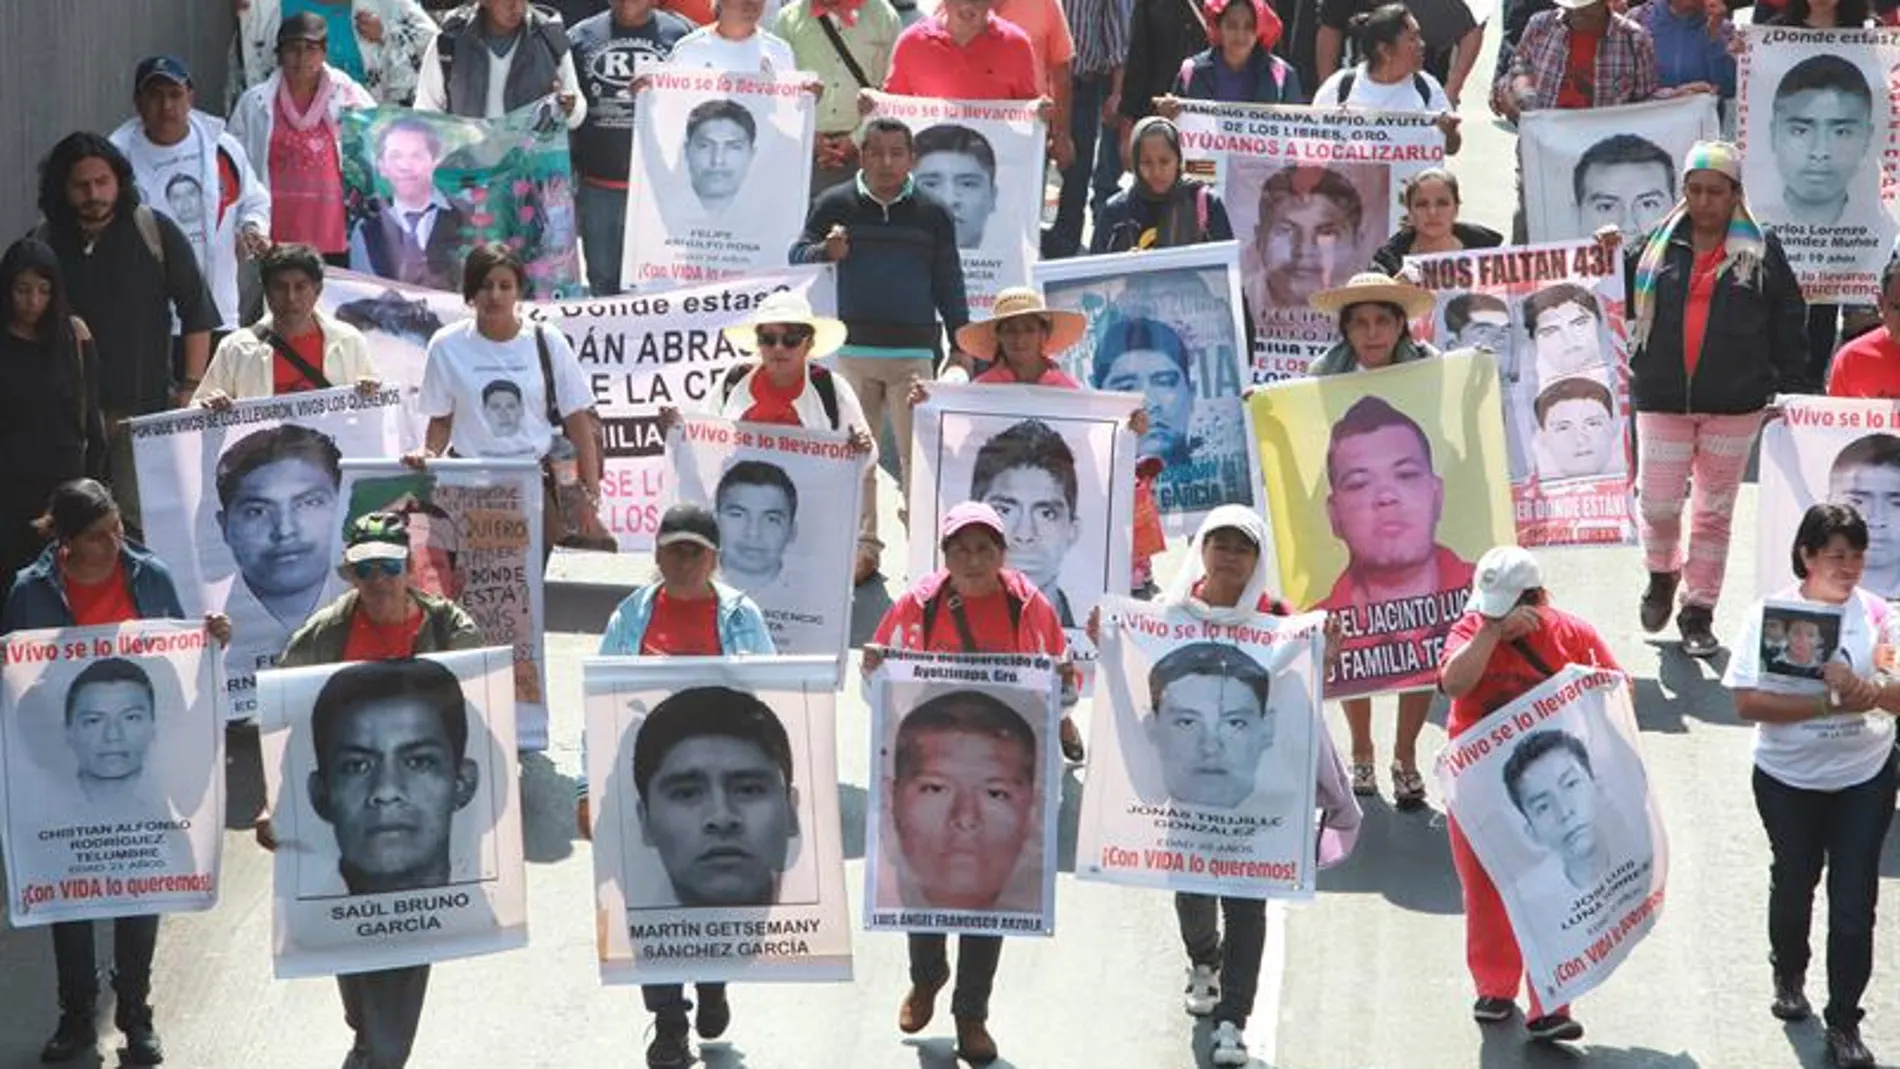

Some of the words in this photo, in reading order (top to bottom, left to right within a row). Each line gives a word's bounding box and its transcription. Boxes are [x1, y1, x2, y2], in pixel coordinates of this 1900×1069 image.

[695, 76, 713, 90] se
[922, 104, 940, 118] se
[1222, 121, 1243, 133] DE
[1249, 123, 1279, 136] LOS
[1286, 142, 1297, 156] A
[1305, 143, 1443, 160] LOCALIZARLO
[1477, 248, 1569, 286] FALTAN
[626, 371, 672, 405] LA
[1839, 411, 1861, 428] se
[1866, 410, 1884, 429] lo
[602, 422, 665, 449] ILIA
[734, 431, 753, 446] se
[757, 432, 776, 450] lo
[603, 469, 633, 498] SE
[611, 503, 658, 533] LOS
[1339, 606, 1365, 637] EL
[1366, 597, 1438, 635] JACINTO
[1173, 622, 1196, 640] se
[4, 640, 57, 664] ¡Vivo
[65, 640, 83, 658] se
[93, 636, 113, 657] lo
[118, 629, 209, 655] llevaron!
[1034, 656, 1051, 670] de
[1339, 641, 1421, 681] FAMILIA
[1490, 722, 1514, 747] se
[1511, 711, 1535, 732] lo
[114, 818, 192, 834] ALFONSO
[1101, 845, 1139, 869] ¡Con
[1144, 849, 1185, 872] VIDA
[1188, 852, 1206, 873] lo
[1208, 857, 1297, 881] queremos!
[60, 877, 102, 899] VIDA
[105, 875, 122, 896] lo
[331, 899, 389, 921] SAÚL
[393, 892, 470, 914] BRUNO
[357, 913, 442, 937] GARCÍA
[630, 919, 699, 940] MARTÍN
[704, 917, 822, 937] GETSEMANY
[643, 942, 734, 959] SÁNCHEZ
[737, 938, 810, 957] GARCÍA
